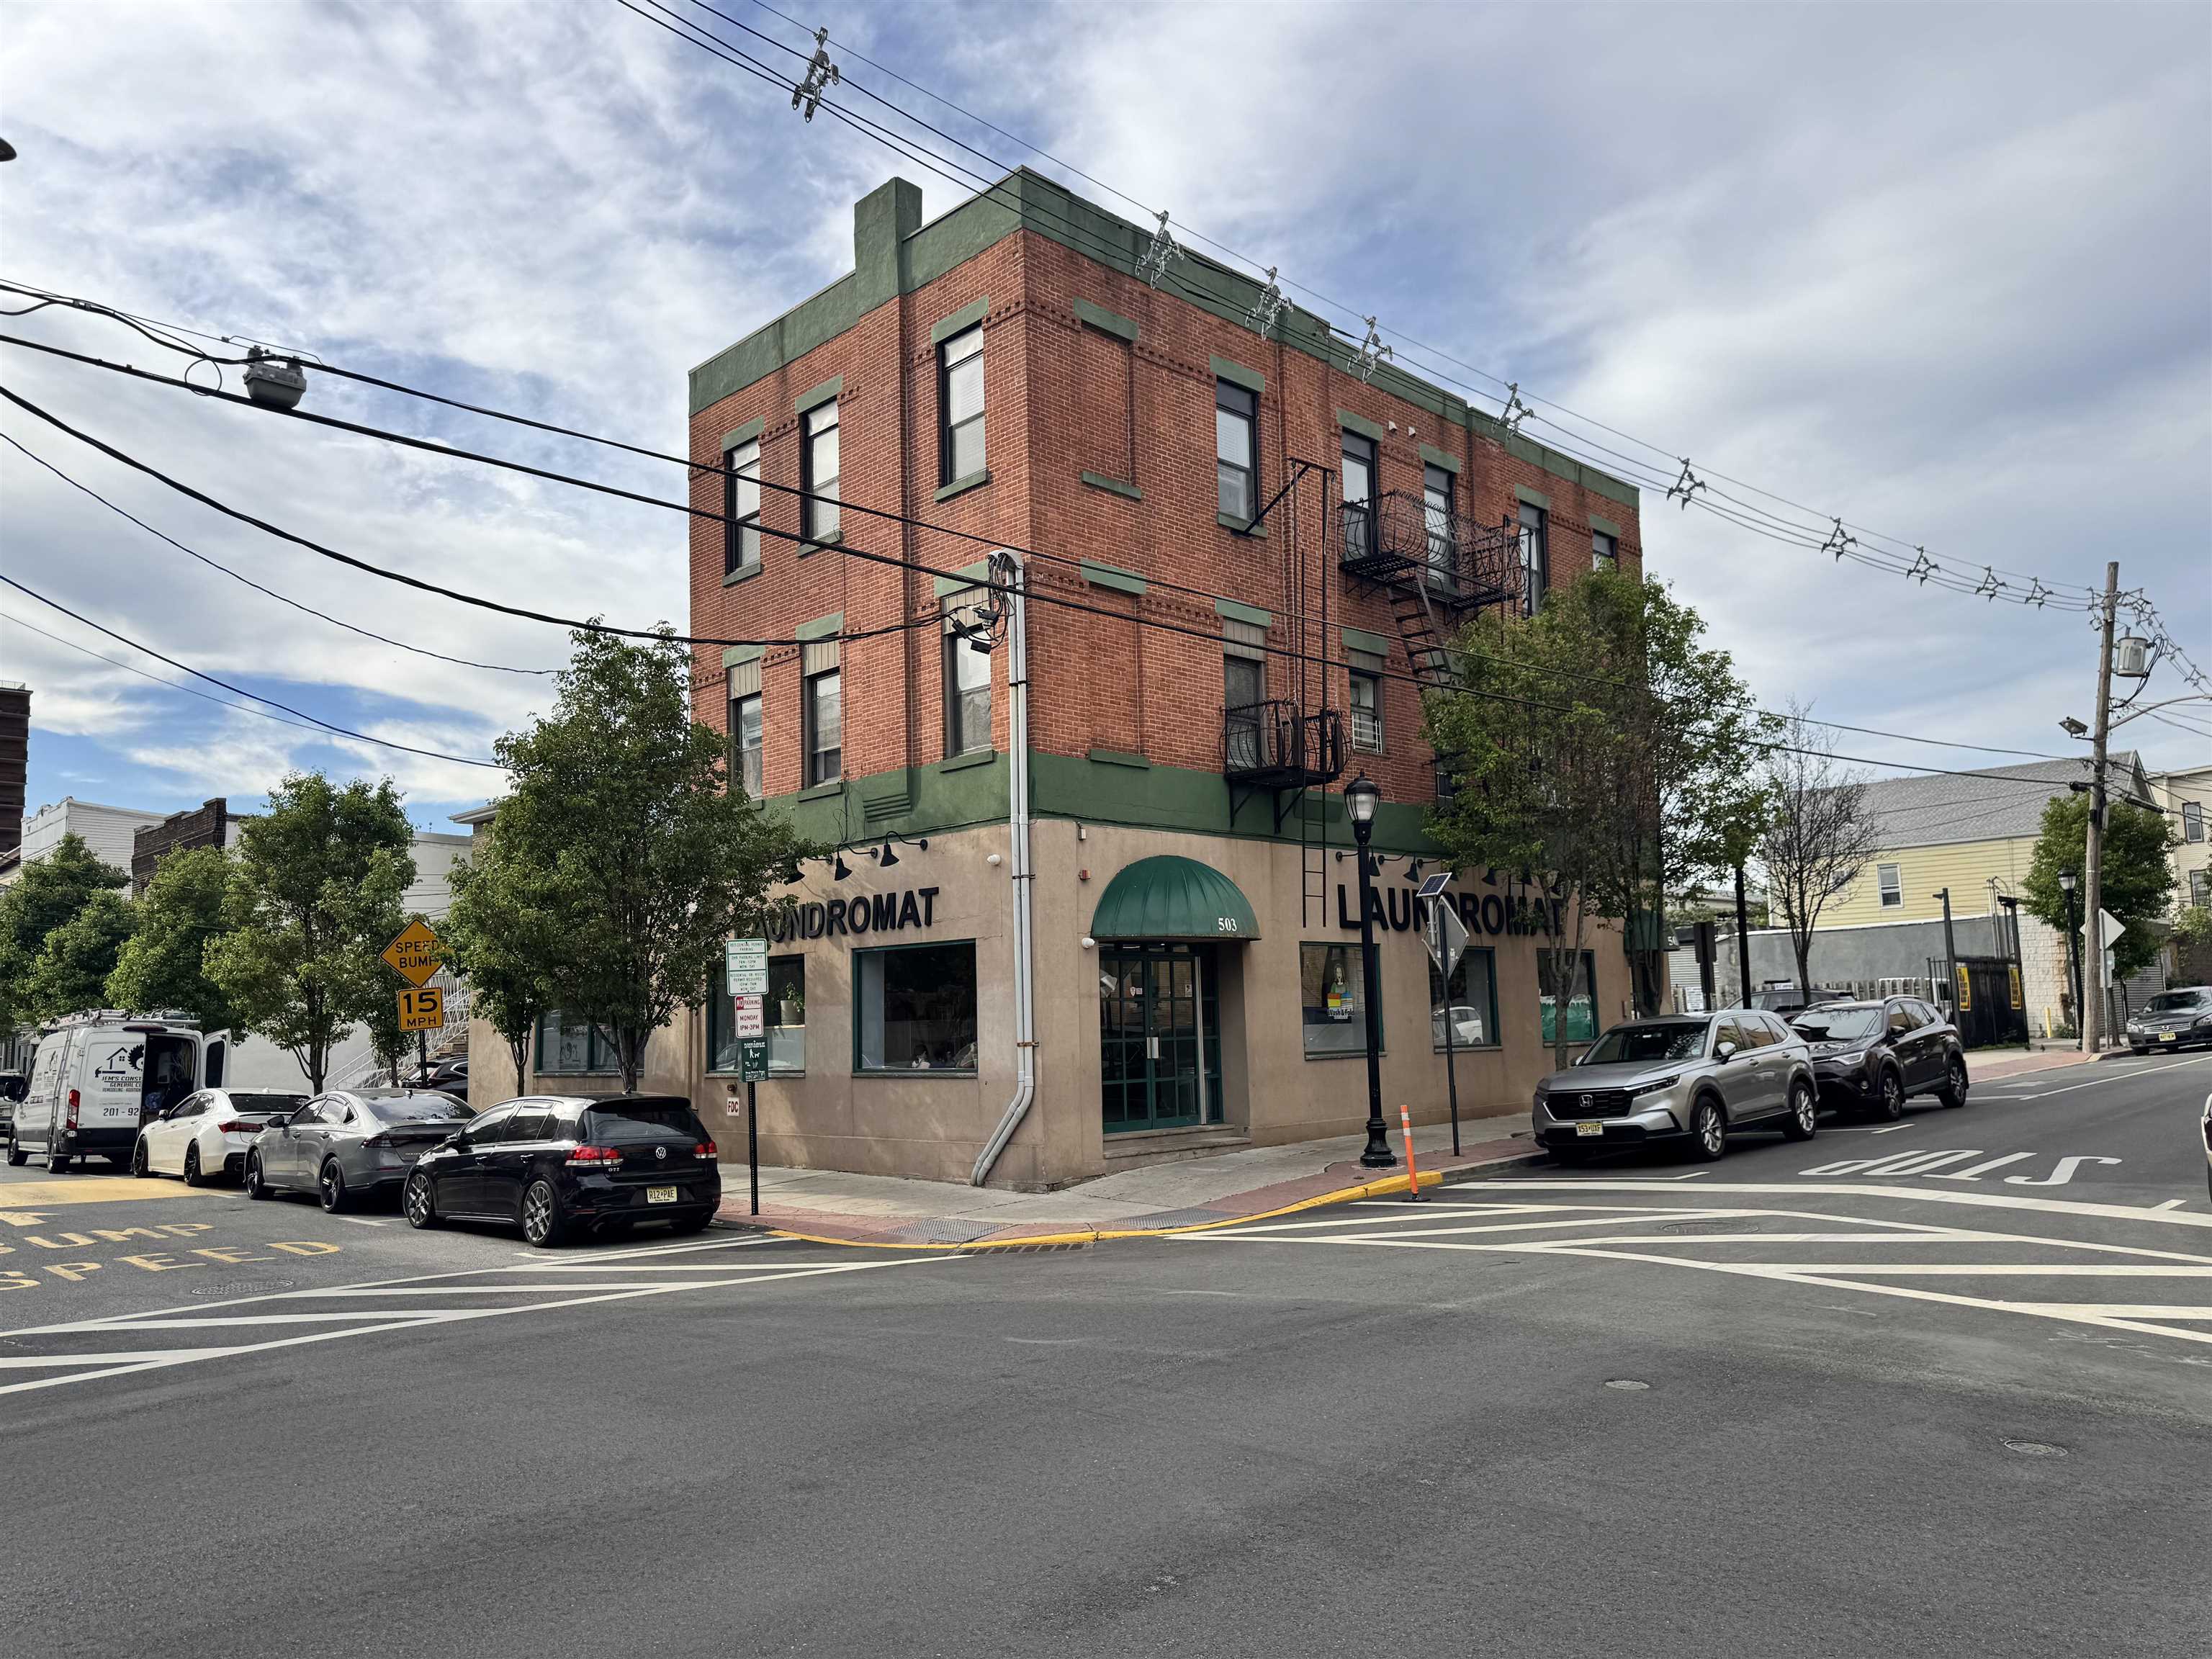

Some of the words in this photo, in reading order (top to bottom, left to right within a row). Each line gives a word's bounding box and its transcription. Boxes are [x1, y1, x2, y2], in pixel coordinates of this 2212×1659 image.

[736, 886, 939, 943] AUNDROMAT
[1337, 884, 1560, 936] LAUNROMAT
[1218, 917, 1237, 932] 503
[403, 992, 438, 1015] 15
[737, 999, 744, 1007] NO
[407, 1016, 436, 1028] MPH
[103, 1107, 119, 1116] 201
[127, 1107, 139, 1116] 92
[727, 1101, 739, 1113] FDC
[1798, 1150, 2123, 1185] STOP
[0, 1223, 215, 1254] UMP
